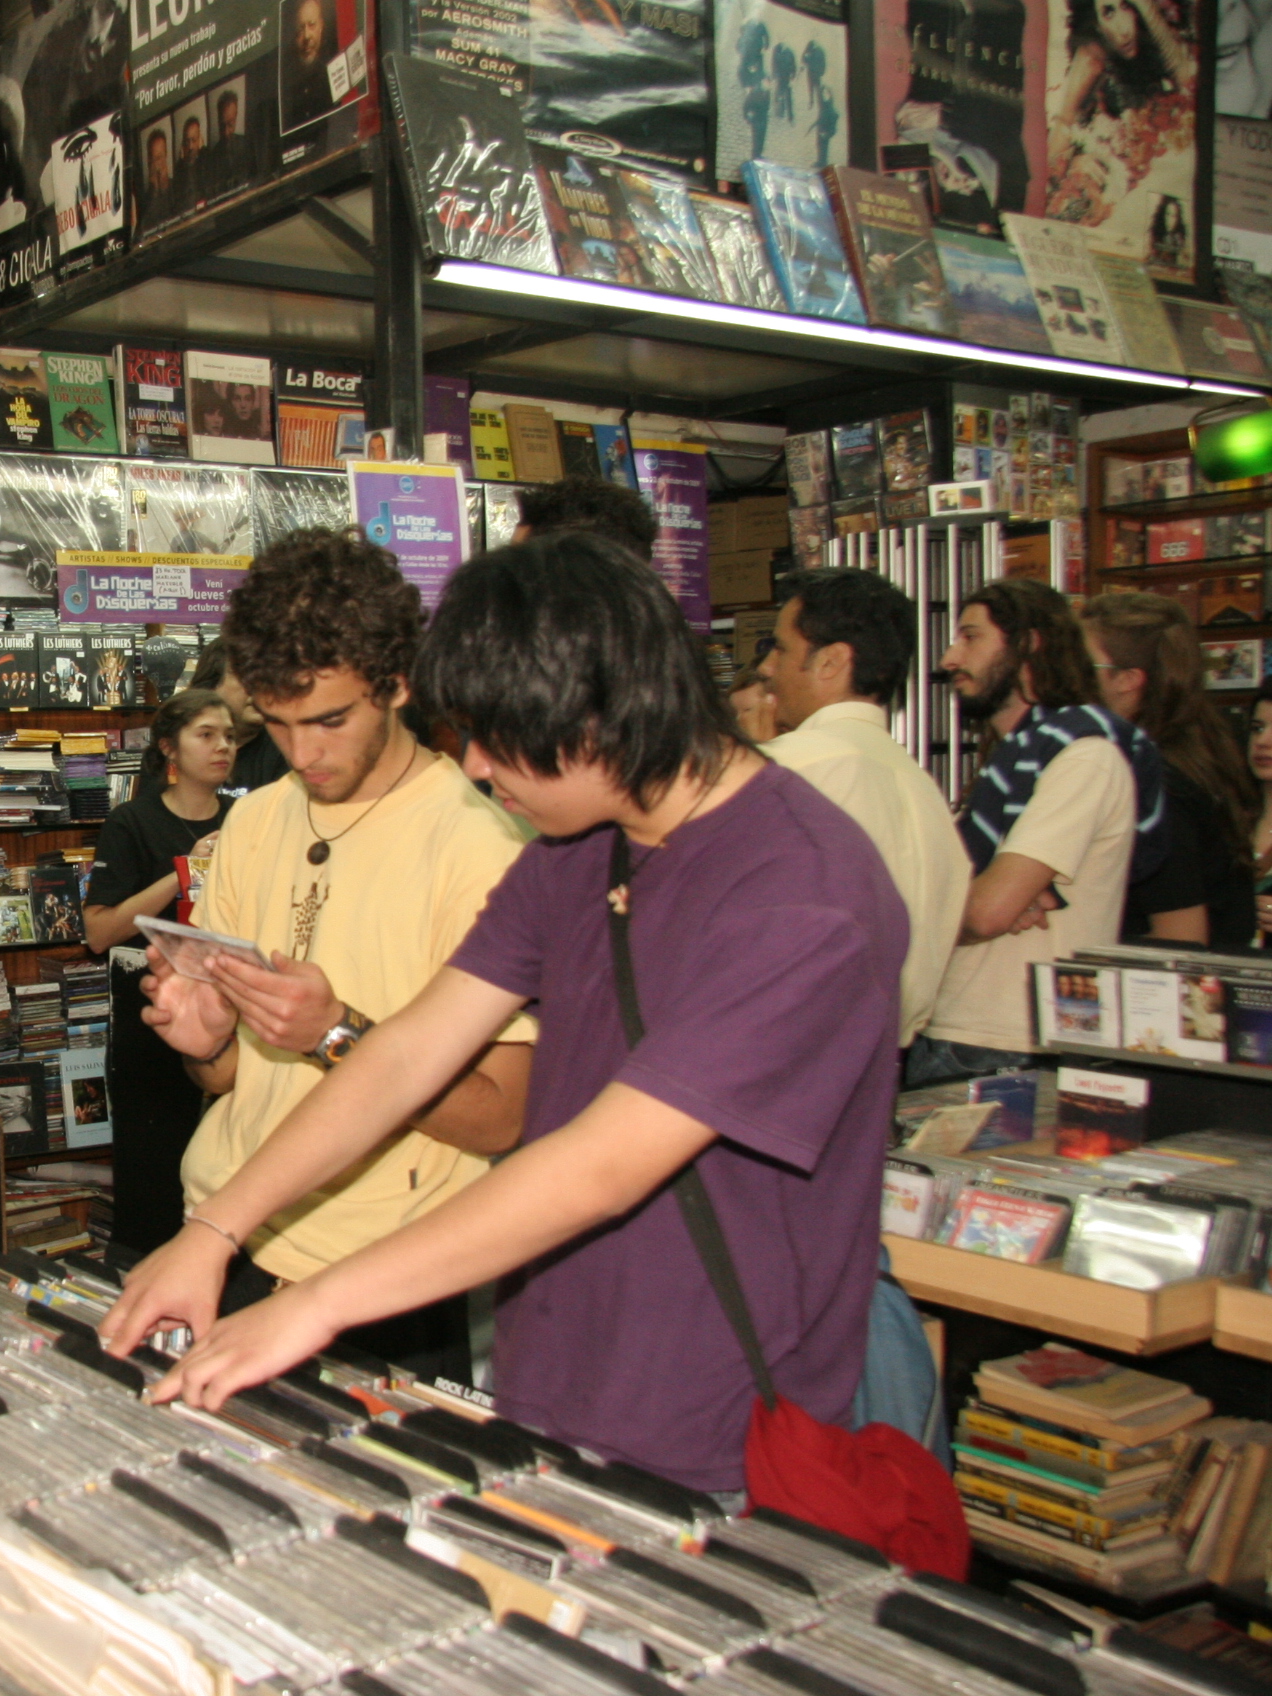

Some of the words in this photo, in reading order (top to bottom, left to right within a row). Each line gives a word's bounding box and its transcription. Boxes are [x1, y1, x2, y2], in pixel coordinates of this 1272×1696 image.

[421, 9, 438, 18] por
[442, 9, 529, 38] AEROSMITH
[133, 52, 159, 83] presenta
[161, 49, 169, 65] su
[170, 40, 189, 59] nuevo
[190, 22, 217, 47] trabajo
[451, 37, 481, 53] SUM
[485, 45, 501, 57] 41
[183, 49, 215, 89] perdón
[435, 49, 475, 66] MACY
[479, 58, 516, 76] GRAY
[9, 234, 53, 288] CIGALA
[48, 356, 103, 379] STEPHEN
[127, 358, 182, 388] KING
[59, 370, 101, 386] KING
[285, 368, 308, 387] La
[312, 370, 357, 392] Boca
[10, 404, 32, 413] HORA
[15, 396, 26, 405] LA
[6, 417, 40, 428] VAMPIRO
[9, 424, 38, 435] stephen
[17, 431, 34, 443] king
[1161, 541, 1189, 558] 666
[69, 555, 105, 563] ARTISTAS
[116, 556, 142, 564] SHOWS
[152, 557, 199, 565] DESCUENTOS
[201, 558, 243, 567] ESPECIALES
[90, 575, 109, 591] La
[111, 575, 153, 591] Noche
[205, 579, 223, 589] Vení
[188, 588, 225, 601] Jueves
[96, 595, 179, 612] Disquerías
[188, 603, 219, 613] octubre
[4, 635, 34, 649] LUTHIERS
[43, 636, 54, 648] LES
[56, 636, 83, 649] LUTHIERS
[91, 636, 102, 648] LES
[103, 636, 132, 649] LUTHIERS
[434, 1376, 464, 1398] ROCK
